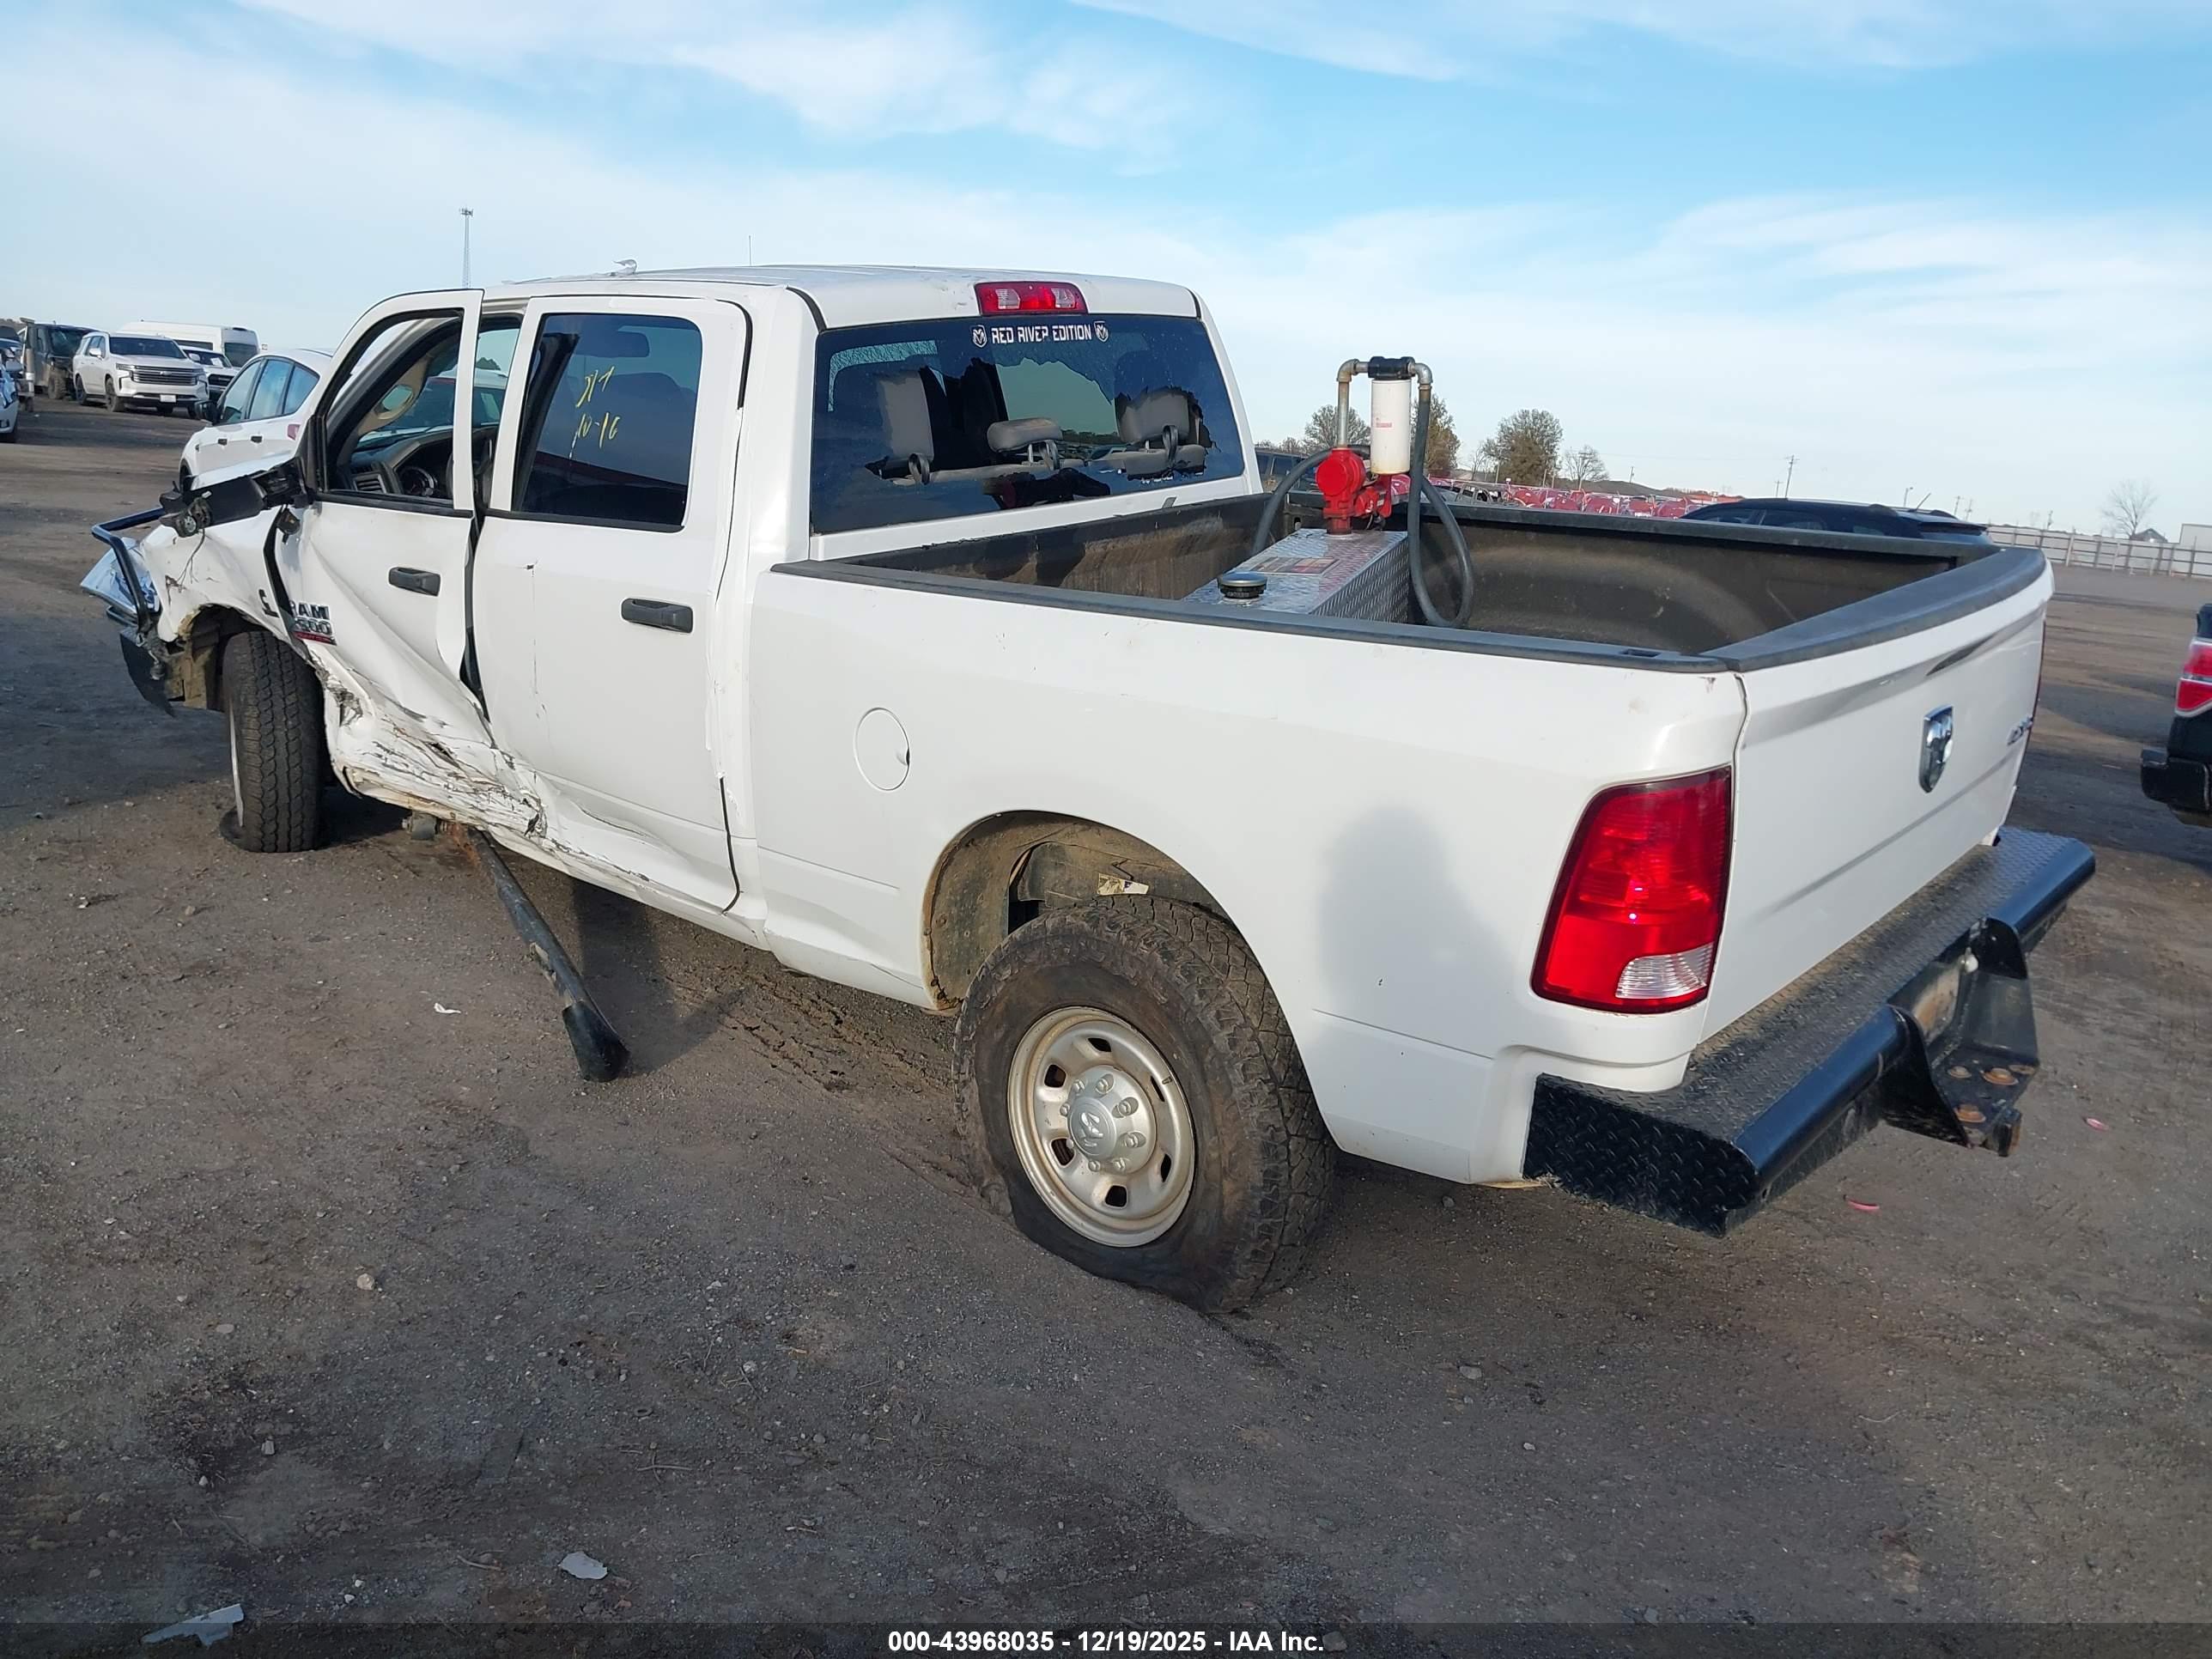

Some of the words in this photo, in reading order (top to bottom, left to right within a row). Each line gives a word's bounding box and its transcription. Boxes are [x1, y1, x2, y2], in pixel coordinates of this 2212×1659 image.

[991, 326, 1013, 344] RED
[1018, 325, 1048, 343] RIVER
[1052, 324, 1092, 342] EDITION
